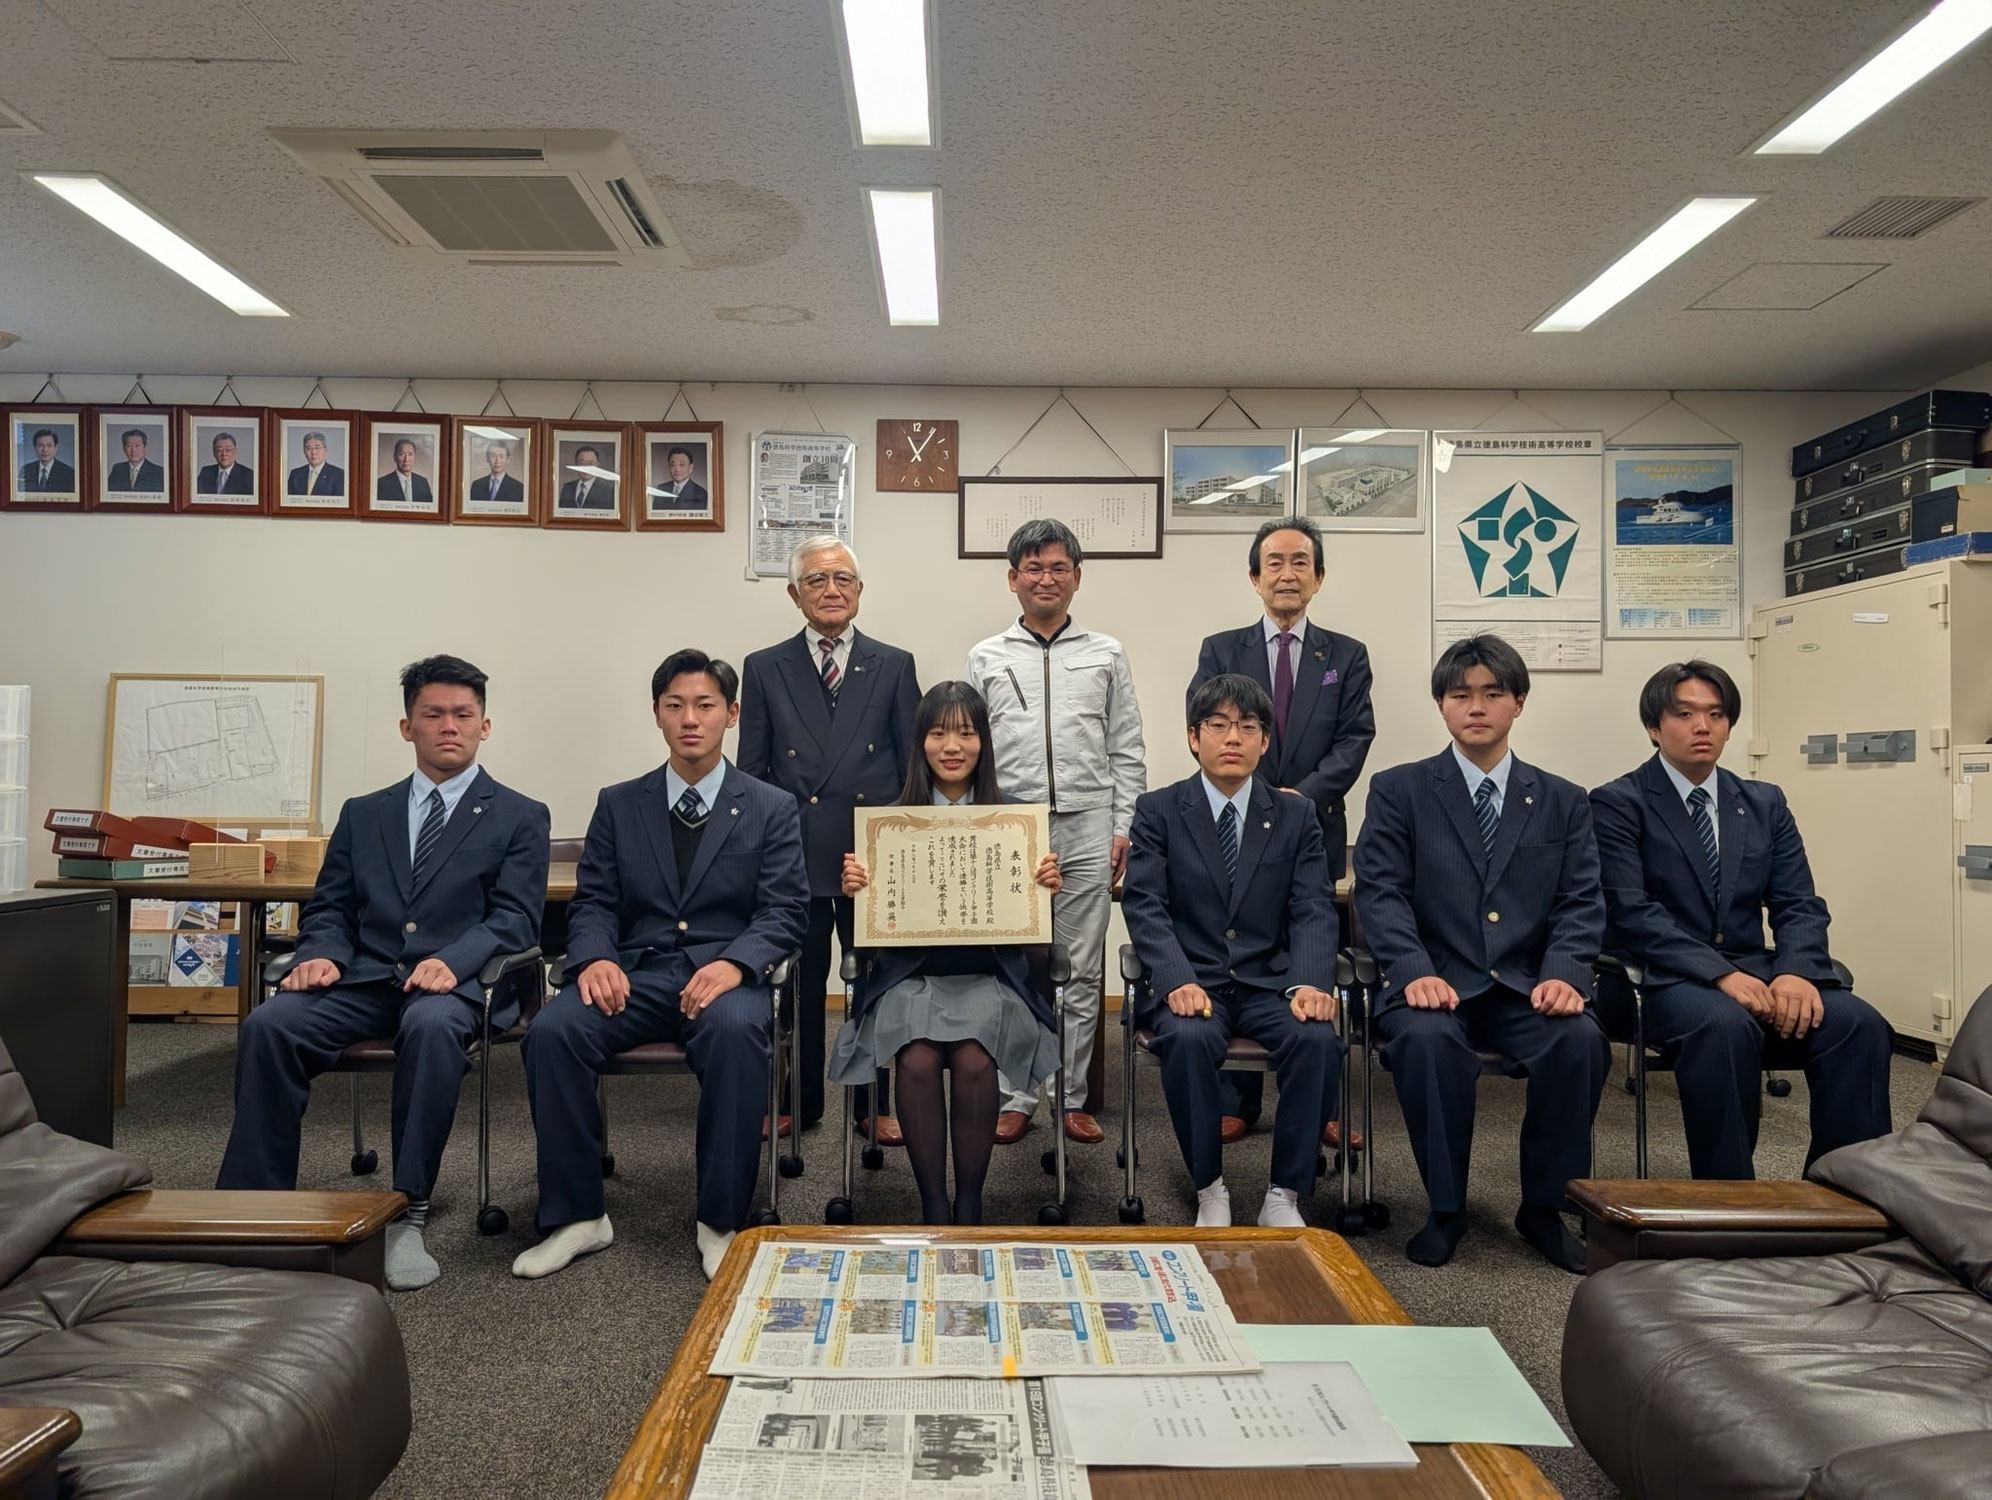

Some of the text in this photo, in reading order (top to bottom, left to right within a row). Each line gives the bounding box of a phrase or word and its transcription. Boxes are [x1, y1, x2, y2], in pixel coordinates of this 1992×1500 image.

[913, 422, 922, 432] 12
[885, 449, 893, 460] 9
[942, 450, 949, 460] 3
[913, 477, 920, 487] 6
[993, 842, 1002, 871] 徳島県立
[1009, 849, 1022, 894] 表彰状
